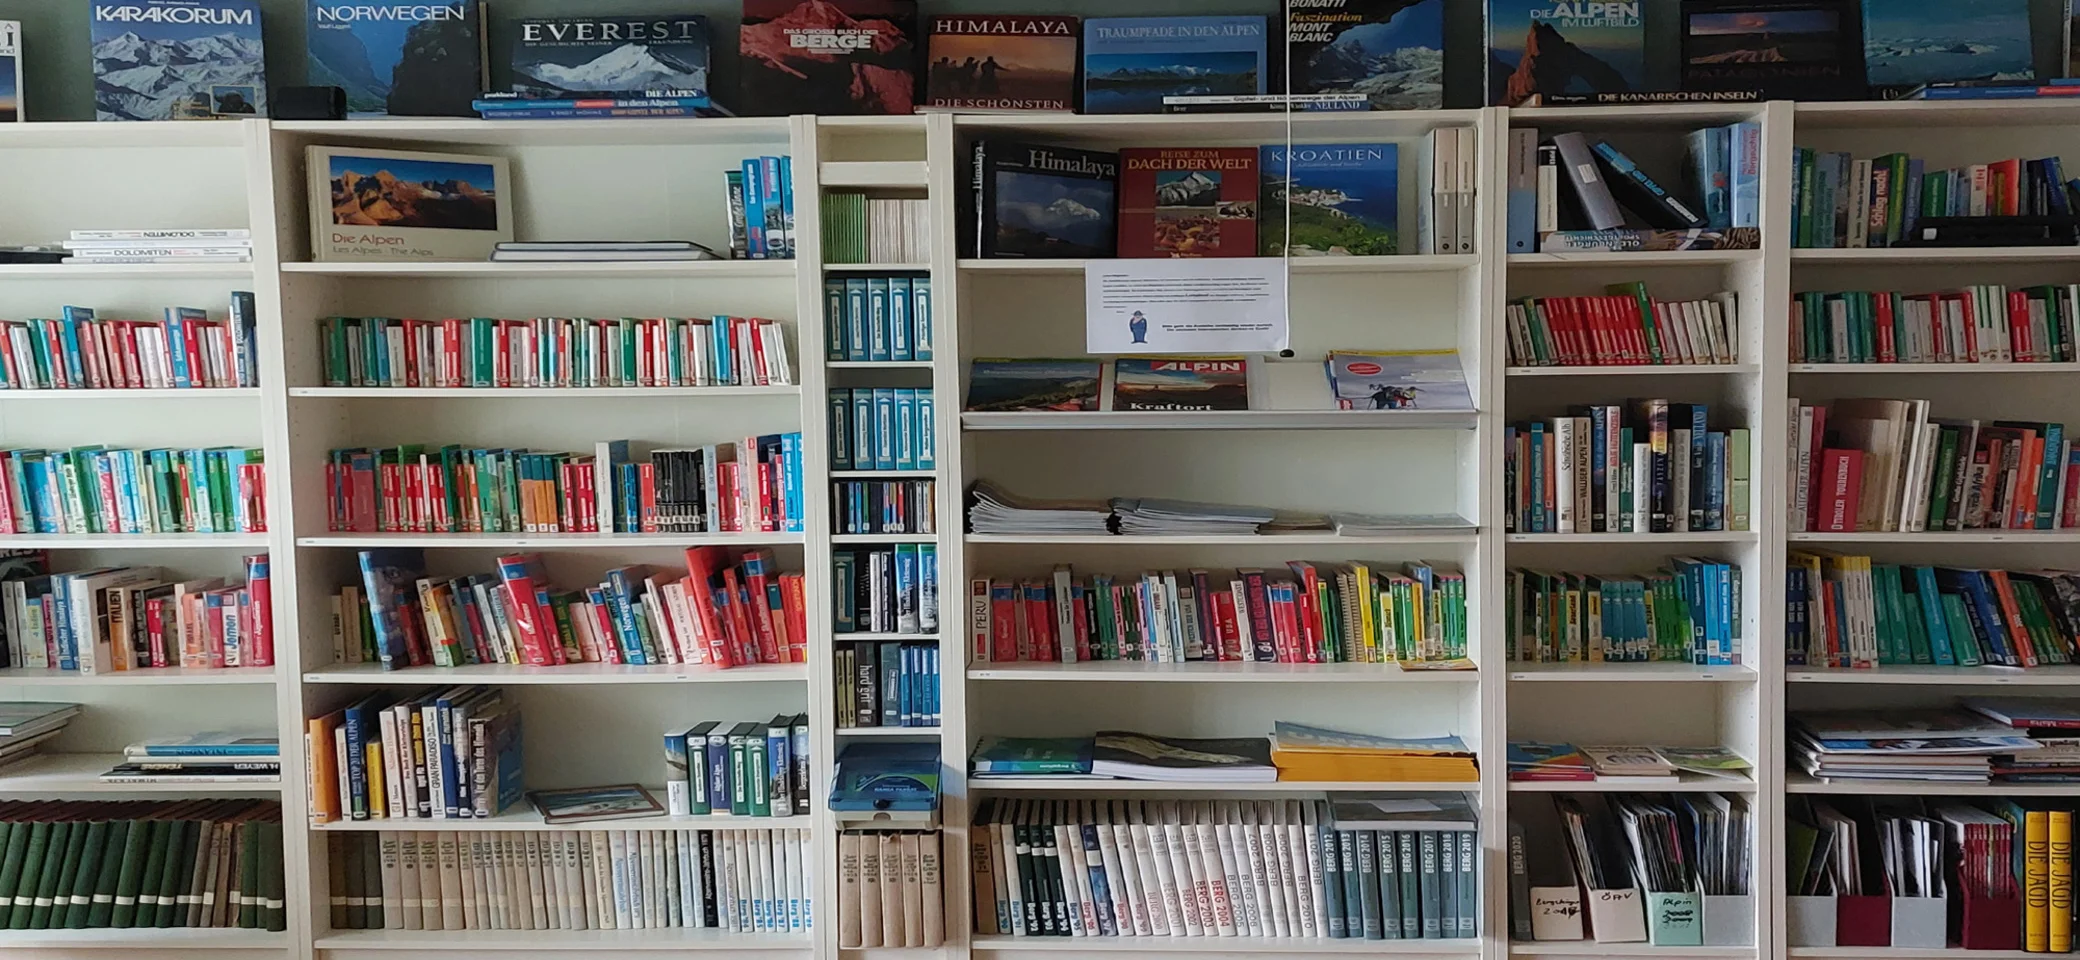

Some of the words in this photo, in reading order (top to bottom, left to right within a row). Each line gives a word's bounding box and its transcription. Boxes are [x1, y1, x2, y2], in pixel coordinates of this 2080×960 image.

[96, 5, 252, 25] KARAKORUM
[317, 5, 465, 21] NORWEGEN
[1290, 12, 1362, 23] Faszination
[1530, 8, 1553, 19] DIE
[1554, 3, 1639, 18] ALPEN
[522, 21, 697, 41] EVEREST
[936, 20, 1070, 35] HIMALAYA
[1096, 26, 1175, 38] TRAUMPFADE
[1177, 26, 1191, 37] IN
[1193, 25, 1219, 36] DEN
[1220, 24, 1259, 36] ALPEN
[1289, 23, 1330, 32] MONT
[1562, 18, 1578, 27] IM
[1579, 18, 1639, 28] LUFTBILD
[790, 34, 872, 49] BERGE
[1289, 33, 1334, 43] BLANC
[650, 99, 678, 108] Alpen
[667, 90, 697, 98] ALPEN
[935, 98, 961, 109] DIE
[966, 97, 1064, 110] SCHÖNSTEN
[1598, 92, 1620, 102] DIE
[1620, 91, 1711, 101] KANARISCHEN
[1713, 90, 1757, 100] INSELN
[1315, 102, 1360, 110] NEULAND
[1028, 149, 1115, 178] Himalaya
[1128, 158, 1172, 170] DACH
[1176, 158, 1203, 169] DER
[1204, 158, 1252, 169] WELT
[1271, 149, 1382, 162] KROATIEN
[972, 146, 984, 190] Himalaya
[1870, 197, 1887, 226] Schlag
[332, 233, 356, 244] Die
[360, 234, 404, 246] Alpen
[351, 247, 383, 256] Alpes
[391, 247, 407, 255] The
[411, 248, 434, 257] Alps
[1155, 362, 1241, 372] ALPIN
[1129, 401, 1214, 410] Kraftort
[1561, 423, 1571, 435] Alb
[1561, 435, 1572, 471] Schwäbische
[1579, 446, 1588, 466] ALPEN
[1800, 451, 1810, 473] ALPEN
[1580, 467, 1588, 498] WALLISER
[109, 590, 123, 624] ITALIEN
[617, 596, 633, 631] Norwegen
[975, 600, 987, 629] PERU
[224, 615, 237, 650] Jemen
[1225, 618, 1234, 634] USA
[857, 665, 873, 686] hard
[857, 687, 874, 703] grit
[348, 719, 358, 741] ALPEN
[472, 724, 484, 747] Himmels
[350, 742, 359, 757] DER
[428, 738, 439, 770] PARADISO
[473, 748, 484, 757] des
[352, 766, 360, 780] TOP
[474, 759, 485, 774] Toren
[431, 770, 441, 788] GRAN
[474, 774, 485, 782] den
[475, 784, 486, 793] Vor
[1248, 833, 1260, 857] 2007
[1263, 833, 1274, 857] 2008
[1278, 833, 1289, 857] 2009
[1310, 833, 1319, 856] 2011
[1324, 833, 1335, 852] 2012
[1341, 833, 1352, 851] 2013
[1360, 834, 1370, 852] 2014
[1381, 835, 1392, 853] 2015
[1400, 834, 1412, 852] 2016
[1423, 835, 1434, 853] 2017
[1441, 833, 1452, 852] 2018
[1460, 833, 1471, 852] 2019
[1512, 835, 1522, 857] 2020
[1327, 852, 1337, 872] BERG
[1343, 852, 1354, 872] BERG
[1362, 852, 1372, 873] BERG
[1402, 852, 1413, 873] BERG
[1442, 852, 1453, 872] BERG
[1461, 852, 1472, 872] BERG
[2028, 840, 2047, 866] DIE
[2051, 841, 2071, 867] DIE
[1312, 859, 1322, 885] BERG
[1383, 853, 1393, 873] BERG
[1425, 853, 1435, 873] BERG
[1513, 857, 1524, 875] BERG
[1254, 859, 1266, 887] BERG
[1266, 860, 1278, 887] BERG
[1282, 860, 1294, 887] BERG
[1162, 882, 1177, 905] BERG
[1194, 880, 1209, 904] BERG
[1211, 880, 1225, 904] BERG
[1297, 875, 1309, 901] BERG
[1601, 891, 1633, 902] ÖAV
[2028, 869, 2047, 909] JAGD
[2051, 870, 2071, 909] JAGD
[1181, 889, 1193, 908] BERG
[1227, 874, 1238, 900] BERG
[1233, 903, 1244, 928] 2005
[1012, 901, 1020, 917] Berg
[1027, 902, 1036, 919] Berg
[1041, 902, 1050, 919] Berg
[1056, 902, 1065, 919] Berg
[1070, 903, 1080, 920] Berg
[1083, 902, 1092, 919] Berg
[1100, 903, 1109, 920] Berg
[1168, 907, 1182, 928] 2001
[1200, 906, 1214, 928] 2003
[1216, 906, 1230, 927] 2004
[1301, 904, 1312, 929] 2010
